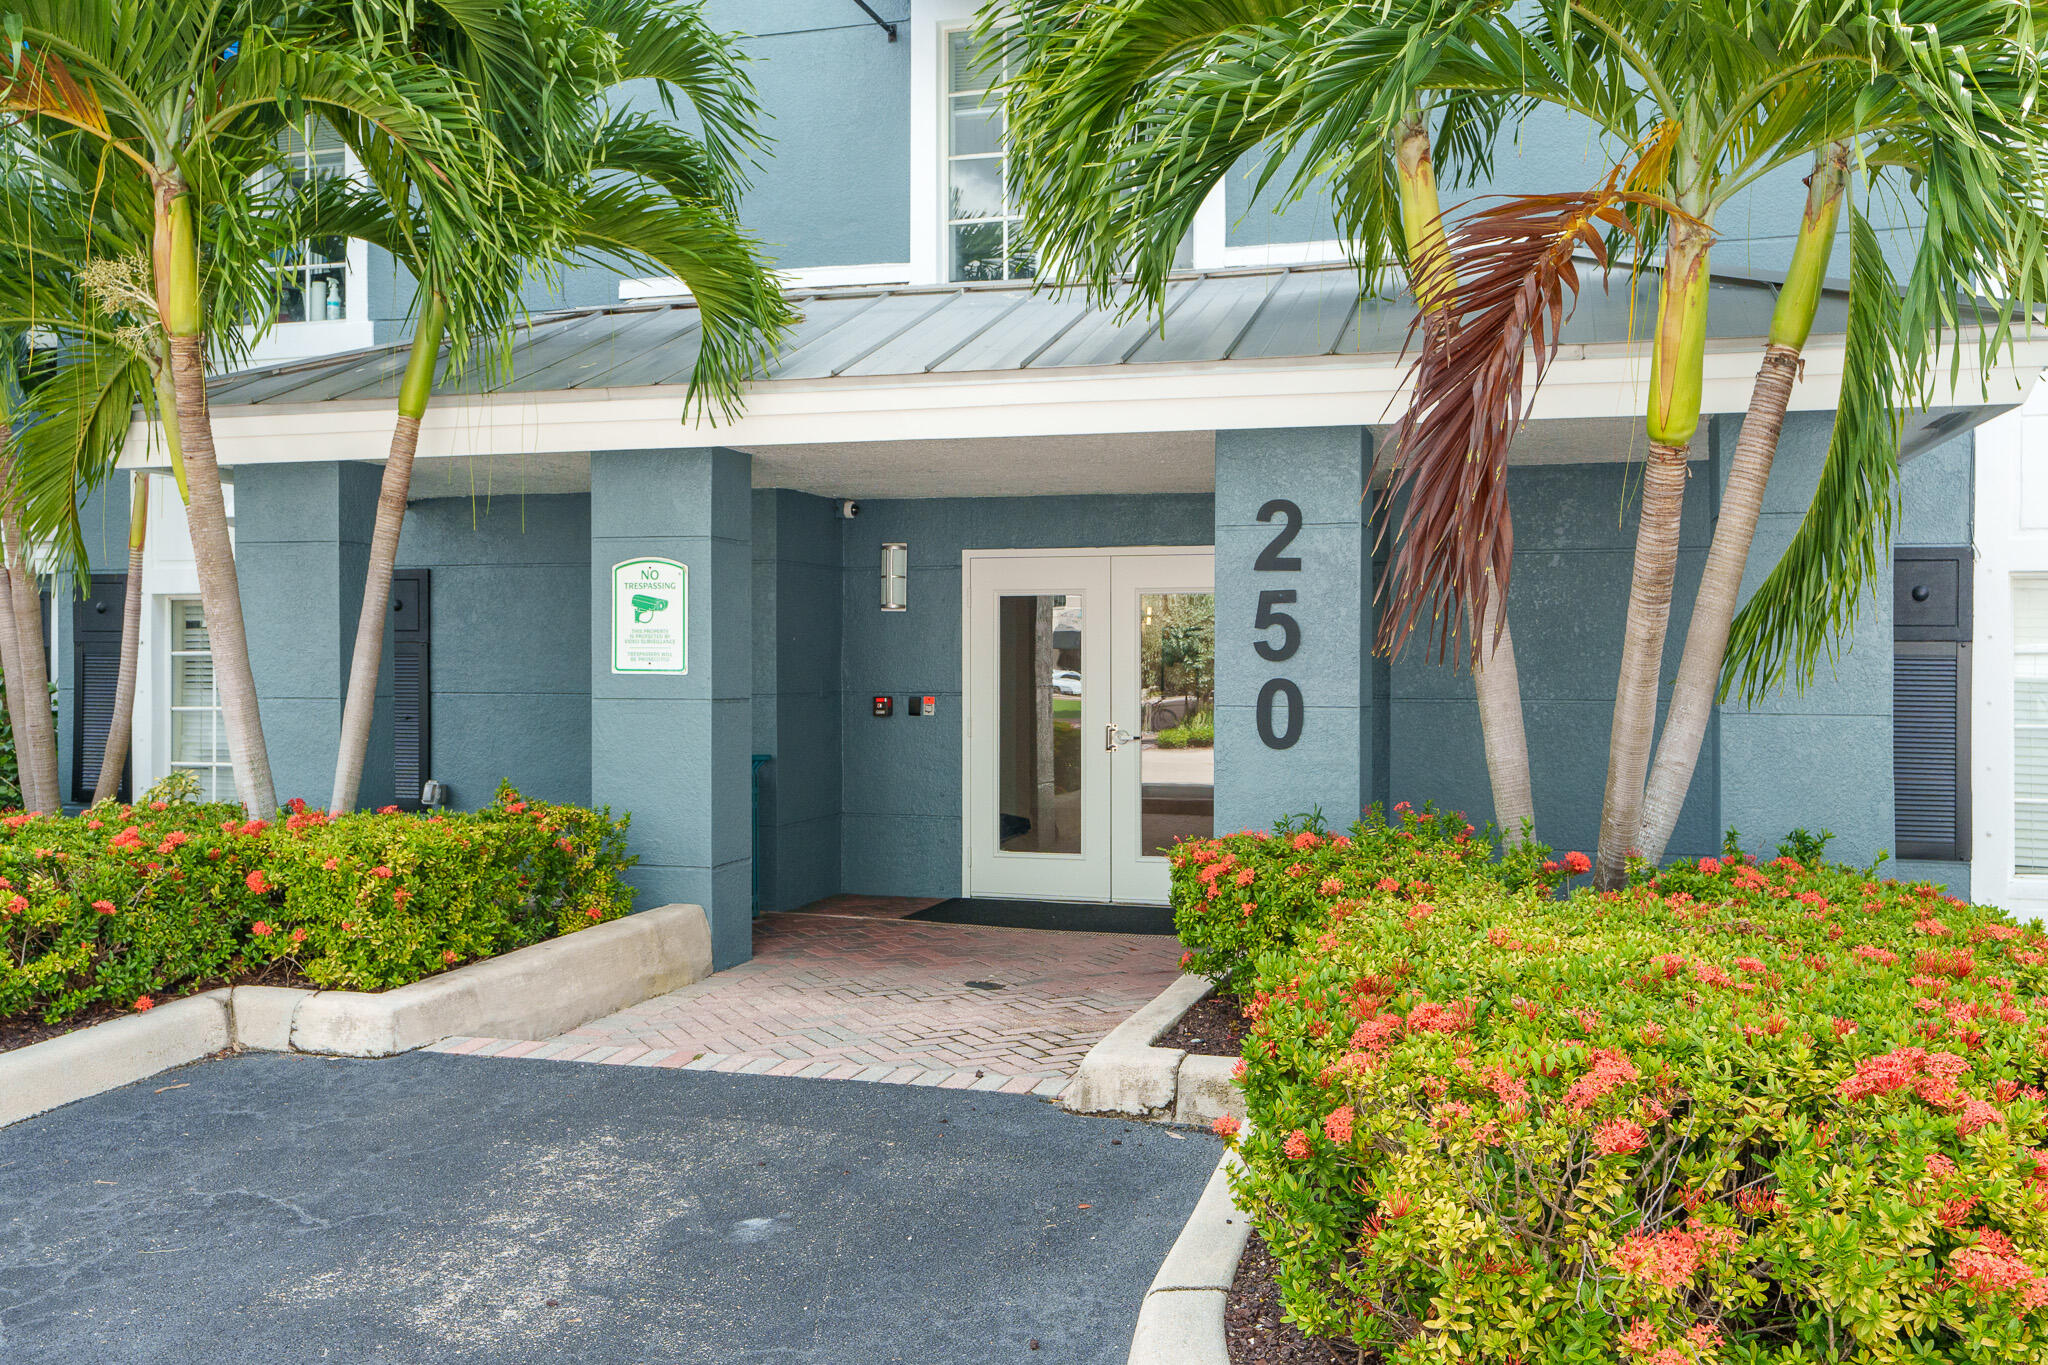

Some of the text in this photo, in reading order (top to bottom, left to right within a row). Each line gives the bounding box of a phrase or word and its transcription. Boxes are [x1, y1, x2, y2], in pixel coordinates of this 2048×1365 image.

[641, 570, 659, 580] NO
[624, 582, 676, 590] TRESPASSING
[1253, 499, 1304, 750] 250
